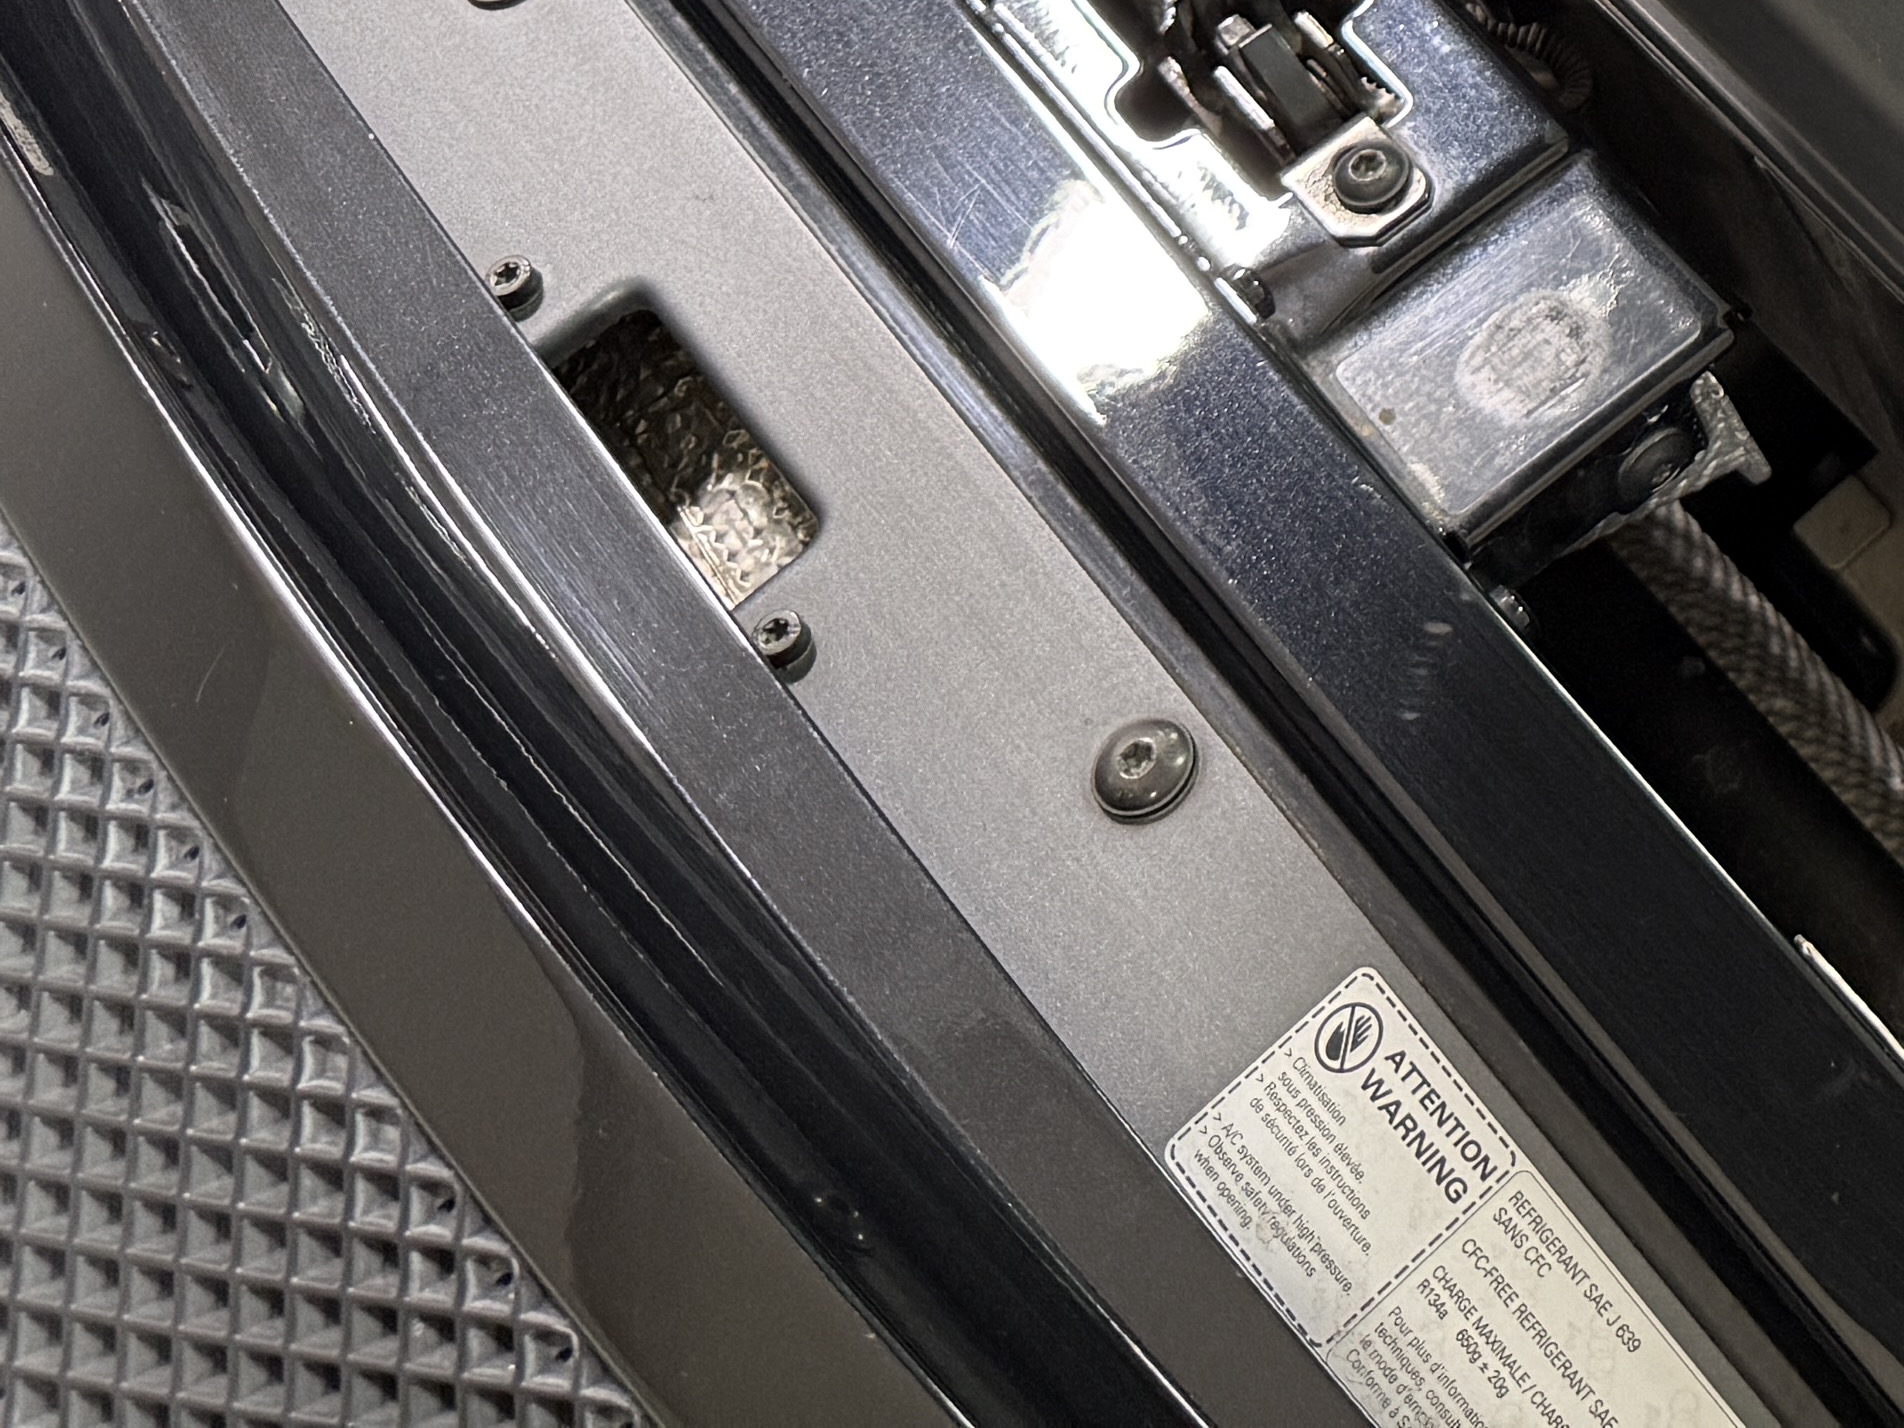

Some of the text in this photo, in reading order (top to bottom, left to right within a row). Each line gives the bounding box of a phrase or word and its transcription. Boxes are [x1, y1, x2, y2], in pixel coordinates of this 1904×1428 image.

[1249, 1097, 1264, 1114] de
[1260, 1112, 1298, 1156] sécurité
[1293, 1152, 1313, 1178] lors
[1310, 1176, 1326, 1194] de
[1277, 1071, 1301, 1099] sous
[1295, 1097, 1336, 1144] pression
[1292, 1056, 1345, 1126] Climatisation
[1362, 1069, 1467, 1203] WARNING
[1385, 1051, 1496, 1181] ATTENTION
[1193, 1149, 1252, 1230] when opening.
[1263, 1081, 1370, 1219] Respectez les instructions
[1207, 1134, 1316, 1277] Observe safety regulations
[1220, 1122, 1352, 1296] A/C system under high pressure.
[1492, 1207, 1552, 1278] SANS CFC
[1432, 1265, 1477, 1320] CHARGE
[1472, 1316, 1530, 1387] MAXIMALE
[1461, 1238, 1519, 1307] CFC-FREE
[1512, 1303, 1595, 1400] REFRIGERANT
[1508, 1190, 1641, 1353] REFRIGERANT SAE J 639
[1345, 1348, 1391, 1410] Conforme
[1358, 1333, 1372, 1352] le
[1368, 1349, 1398, 1384] mode
[1374, 1322, 1425, 1391] techniques,
[1387, 1305, 1413, 1337] Pour
[1405, 1336, 1432, 1363] plus
[1416, 1278, 1448, 1320] R134a
[1455, 1328, 1482, 1364] 650g
[1486, 1369, 1509, 1399] 20g
